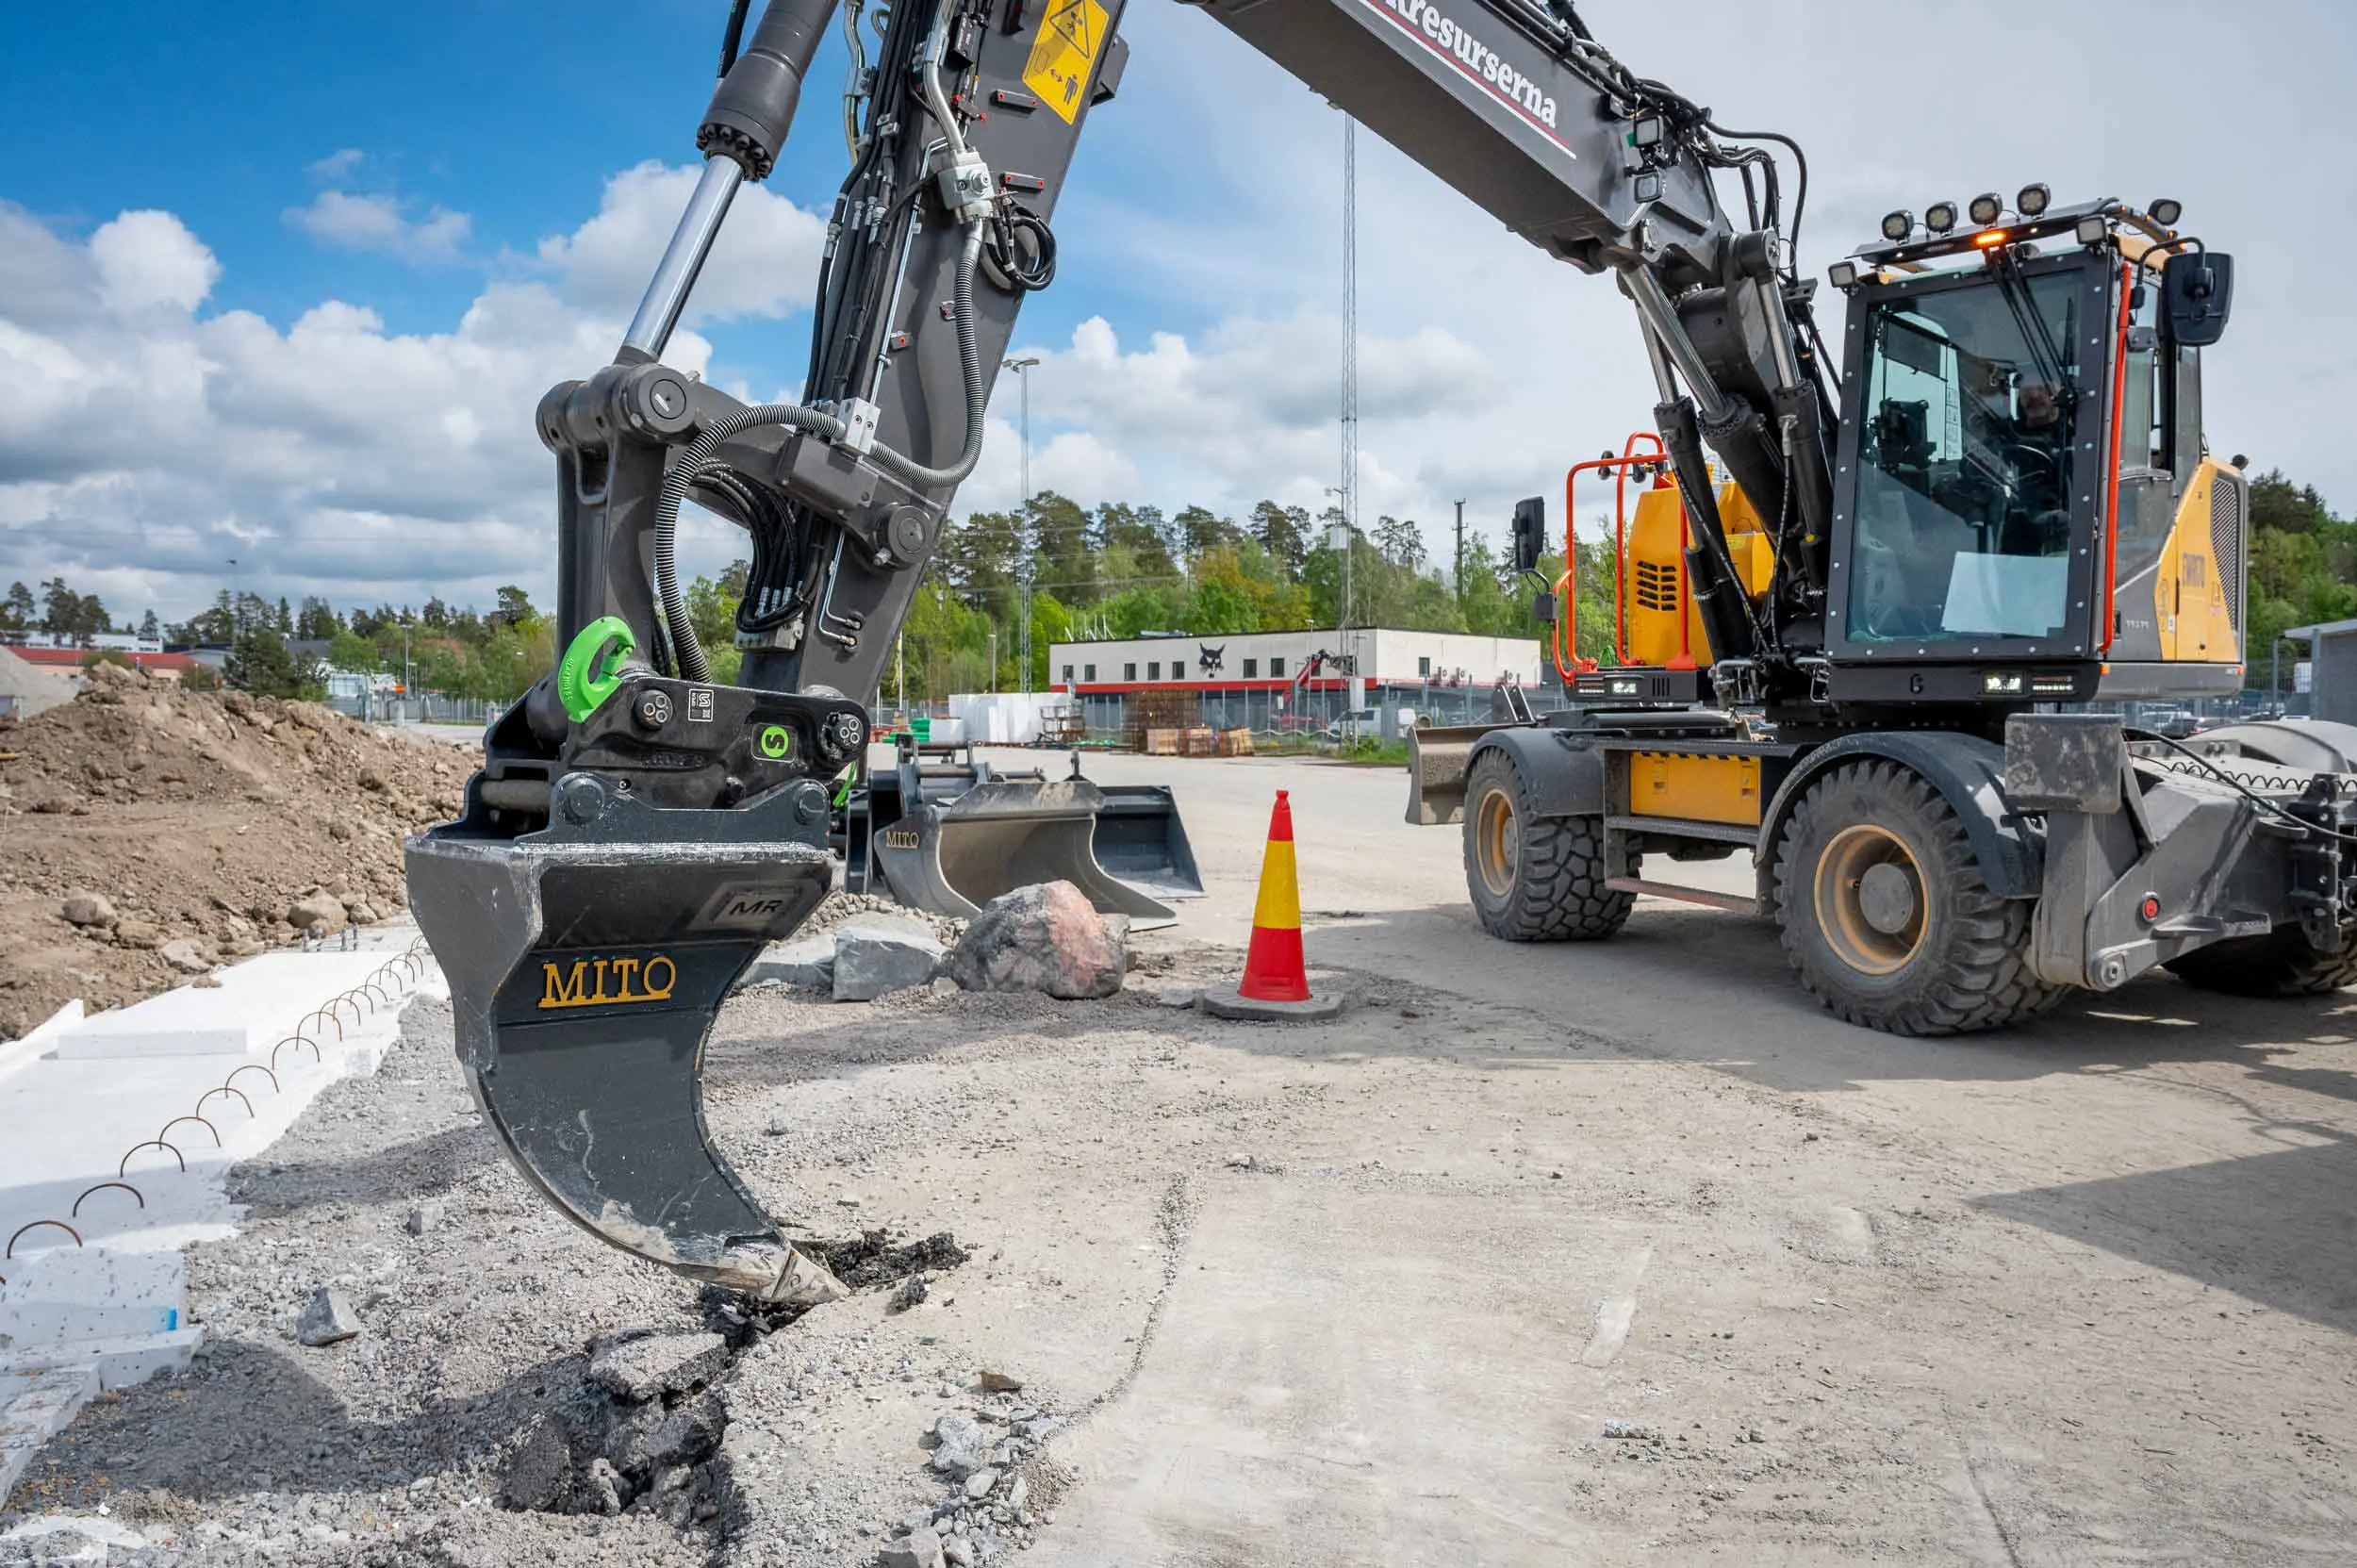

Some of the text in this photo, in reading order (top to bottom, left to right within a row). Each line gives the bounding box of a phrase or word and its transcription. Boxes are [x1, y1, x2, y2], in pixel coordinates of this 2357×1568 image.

[886, 830, 919, 849] MITO
[729, 900, 786, 916] MR
[538, 955, 677, 1009] MITO
